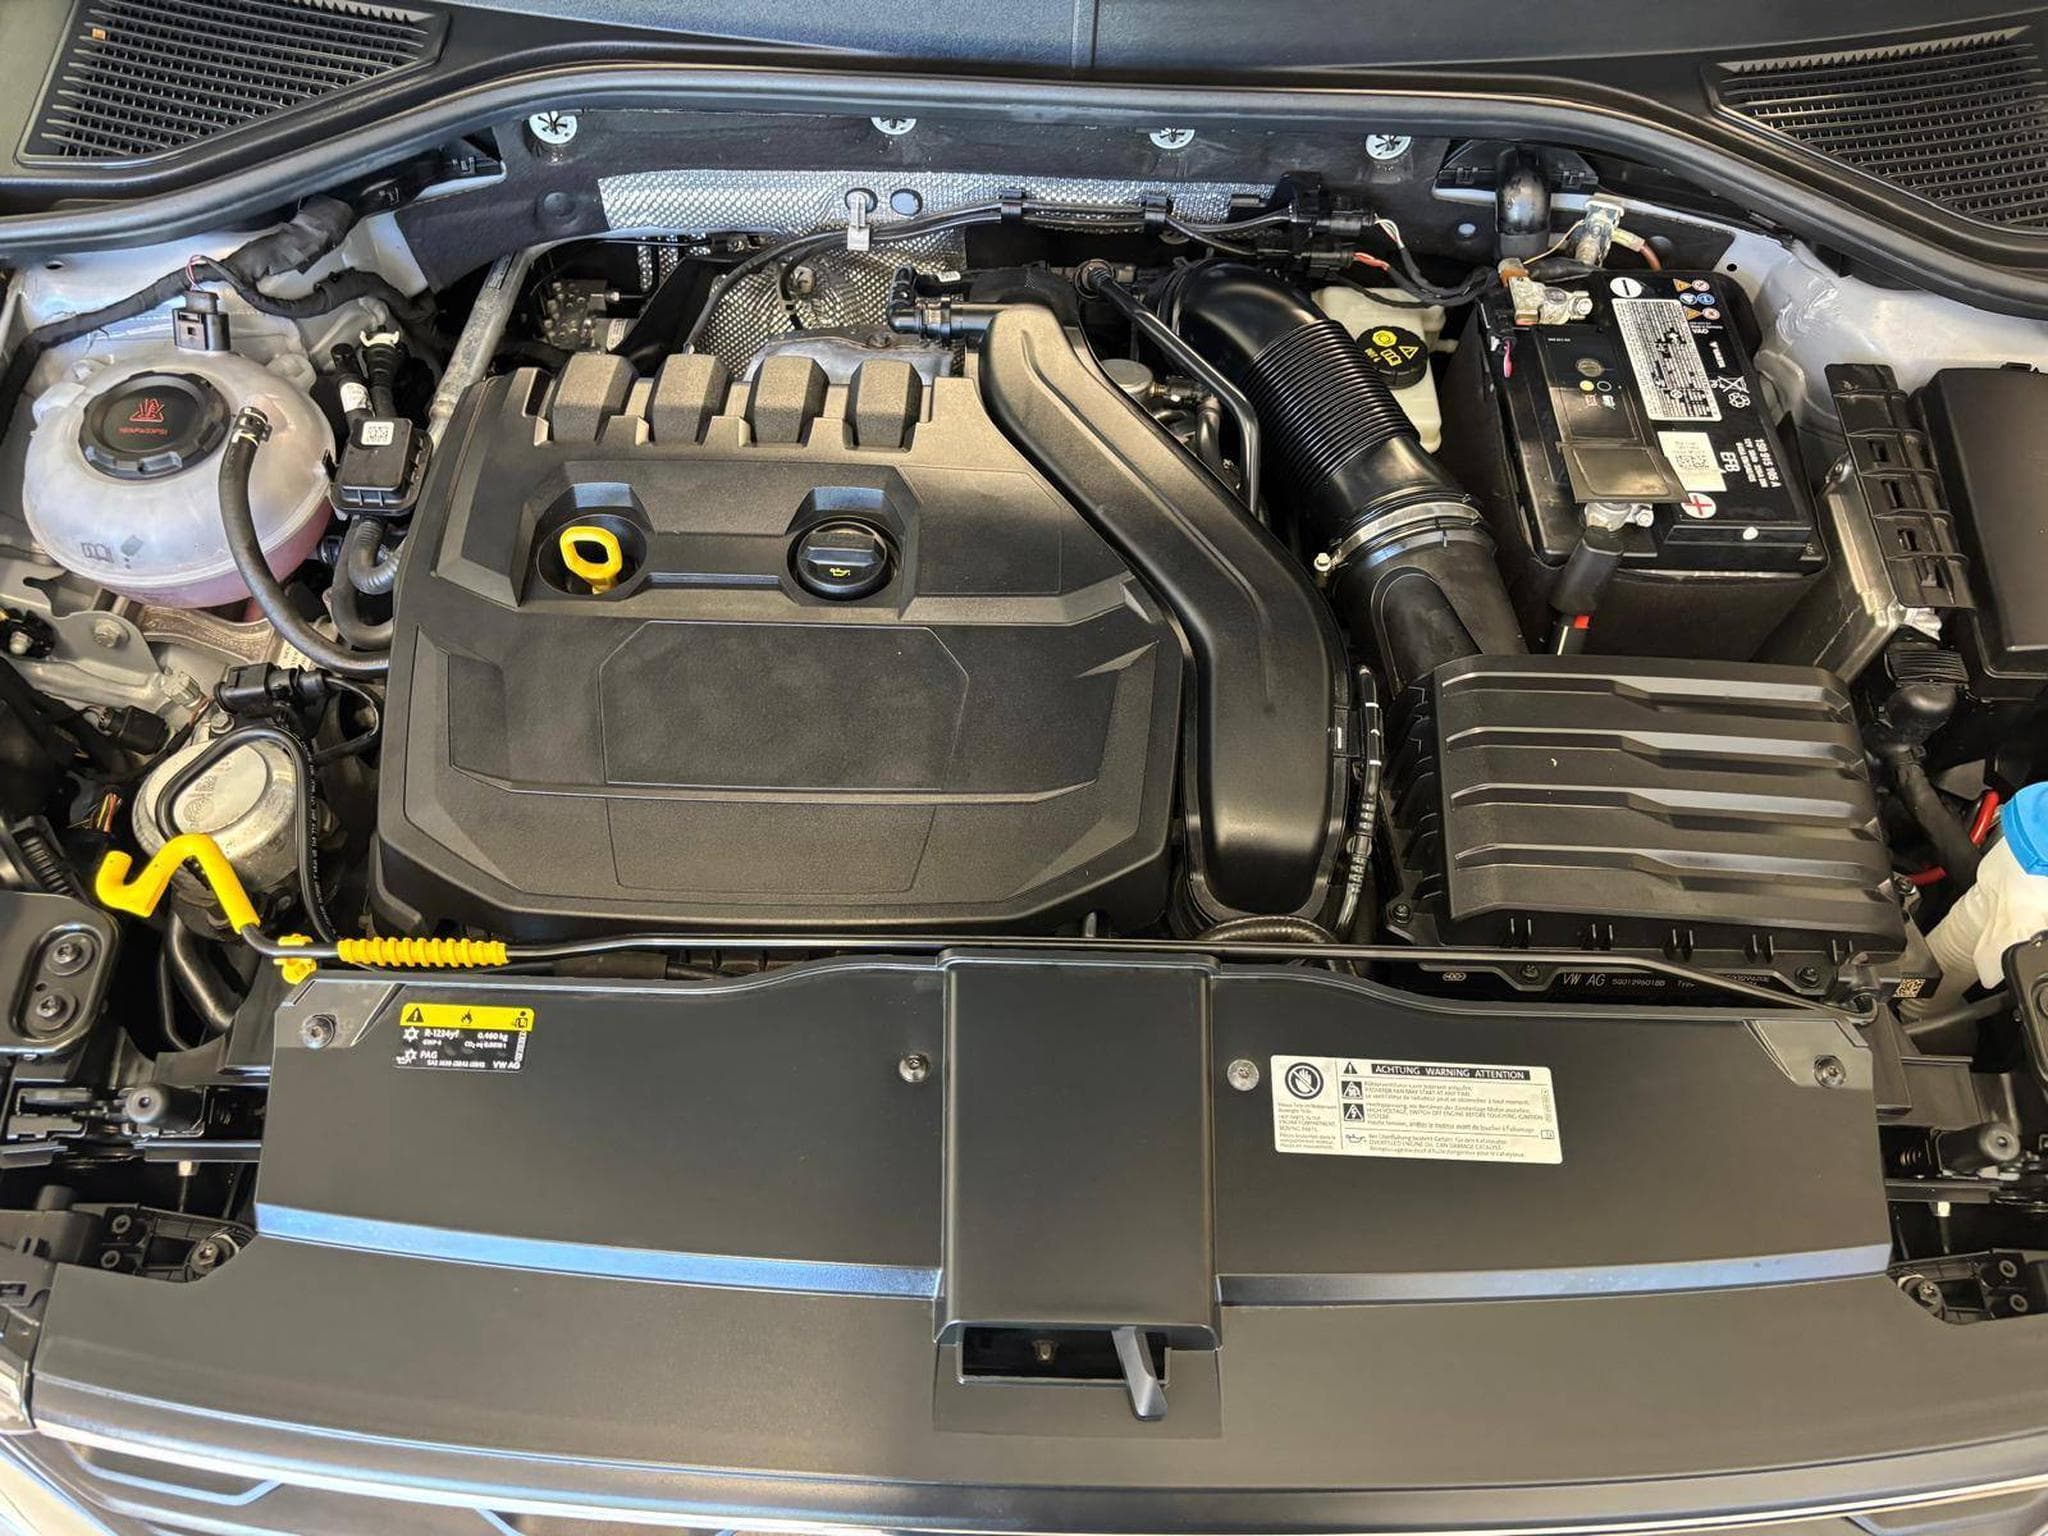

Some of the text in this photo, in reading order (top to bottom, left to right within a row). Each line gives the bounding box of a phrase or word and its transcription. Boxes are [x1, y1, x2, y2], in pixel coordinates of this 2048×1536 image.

[1720, 452, 1740, 472] EFB
[1563, 973, 1581, 985] VW
[1586, 973, 1606, 987] AG
[420, 1050, 438, 1059] PAG
[492, 1060, 507, 1069] VW
[1375, 1065, 1524, 1079] ACHTUNG WARNING ATTENTION
